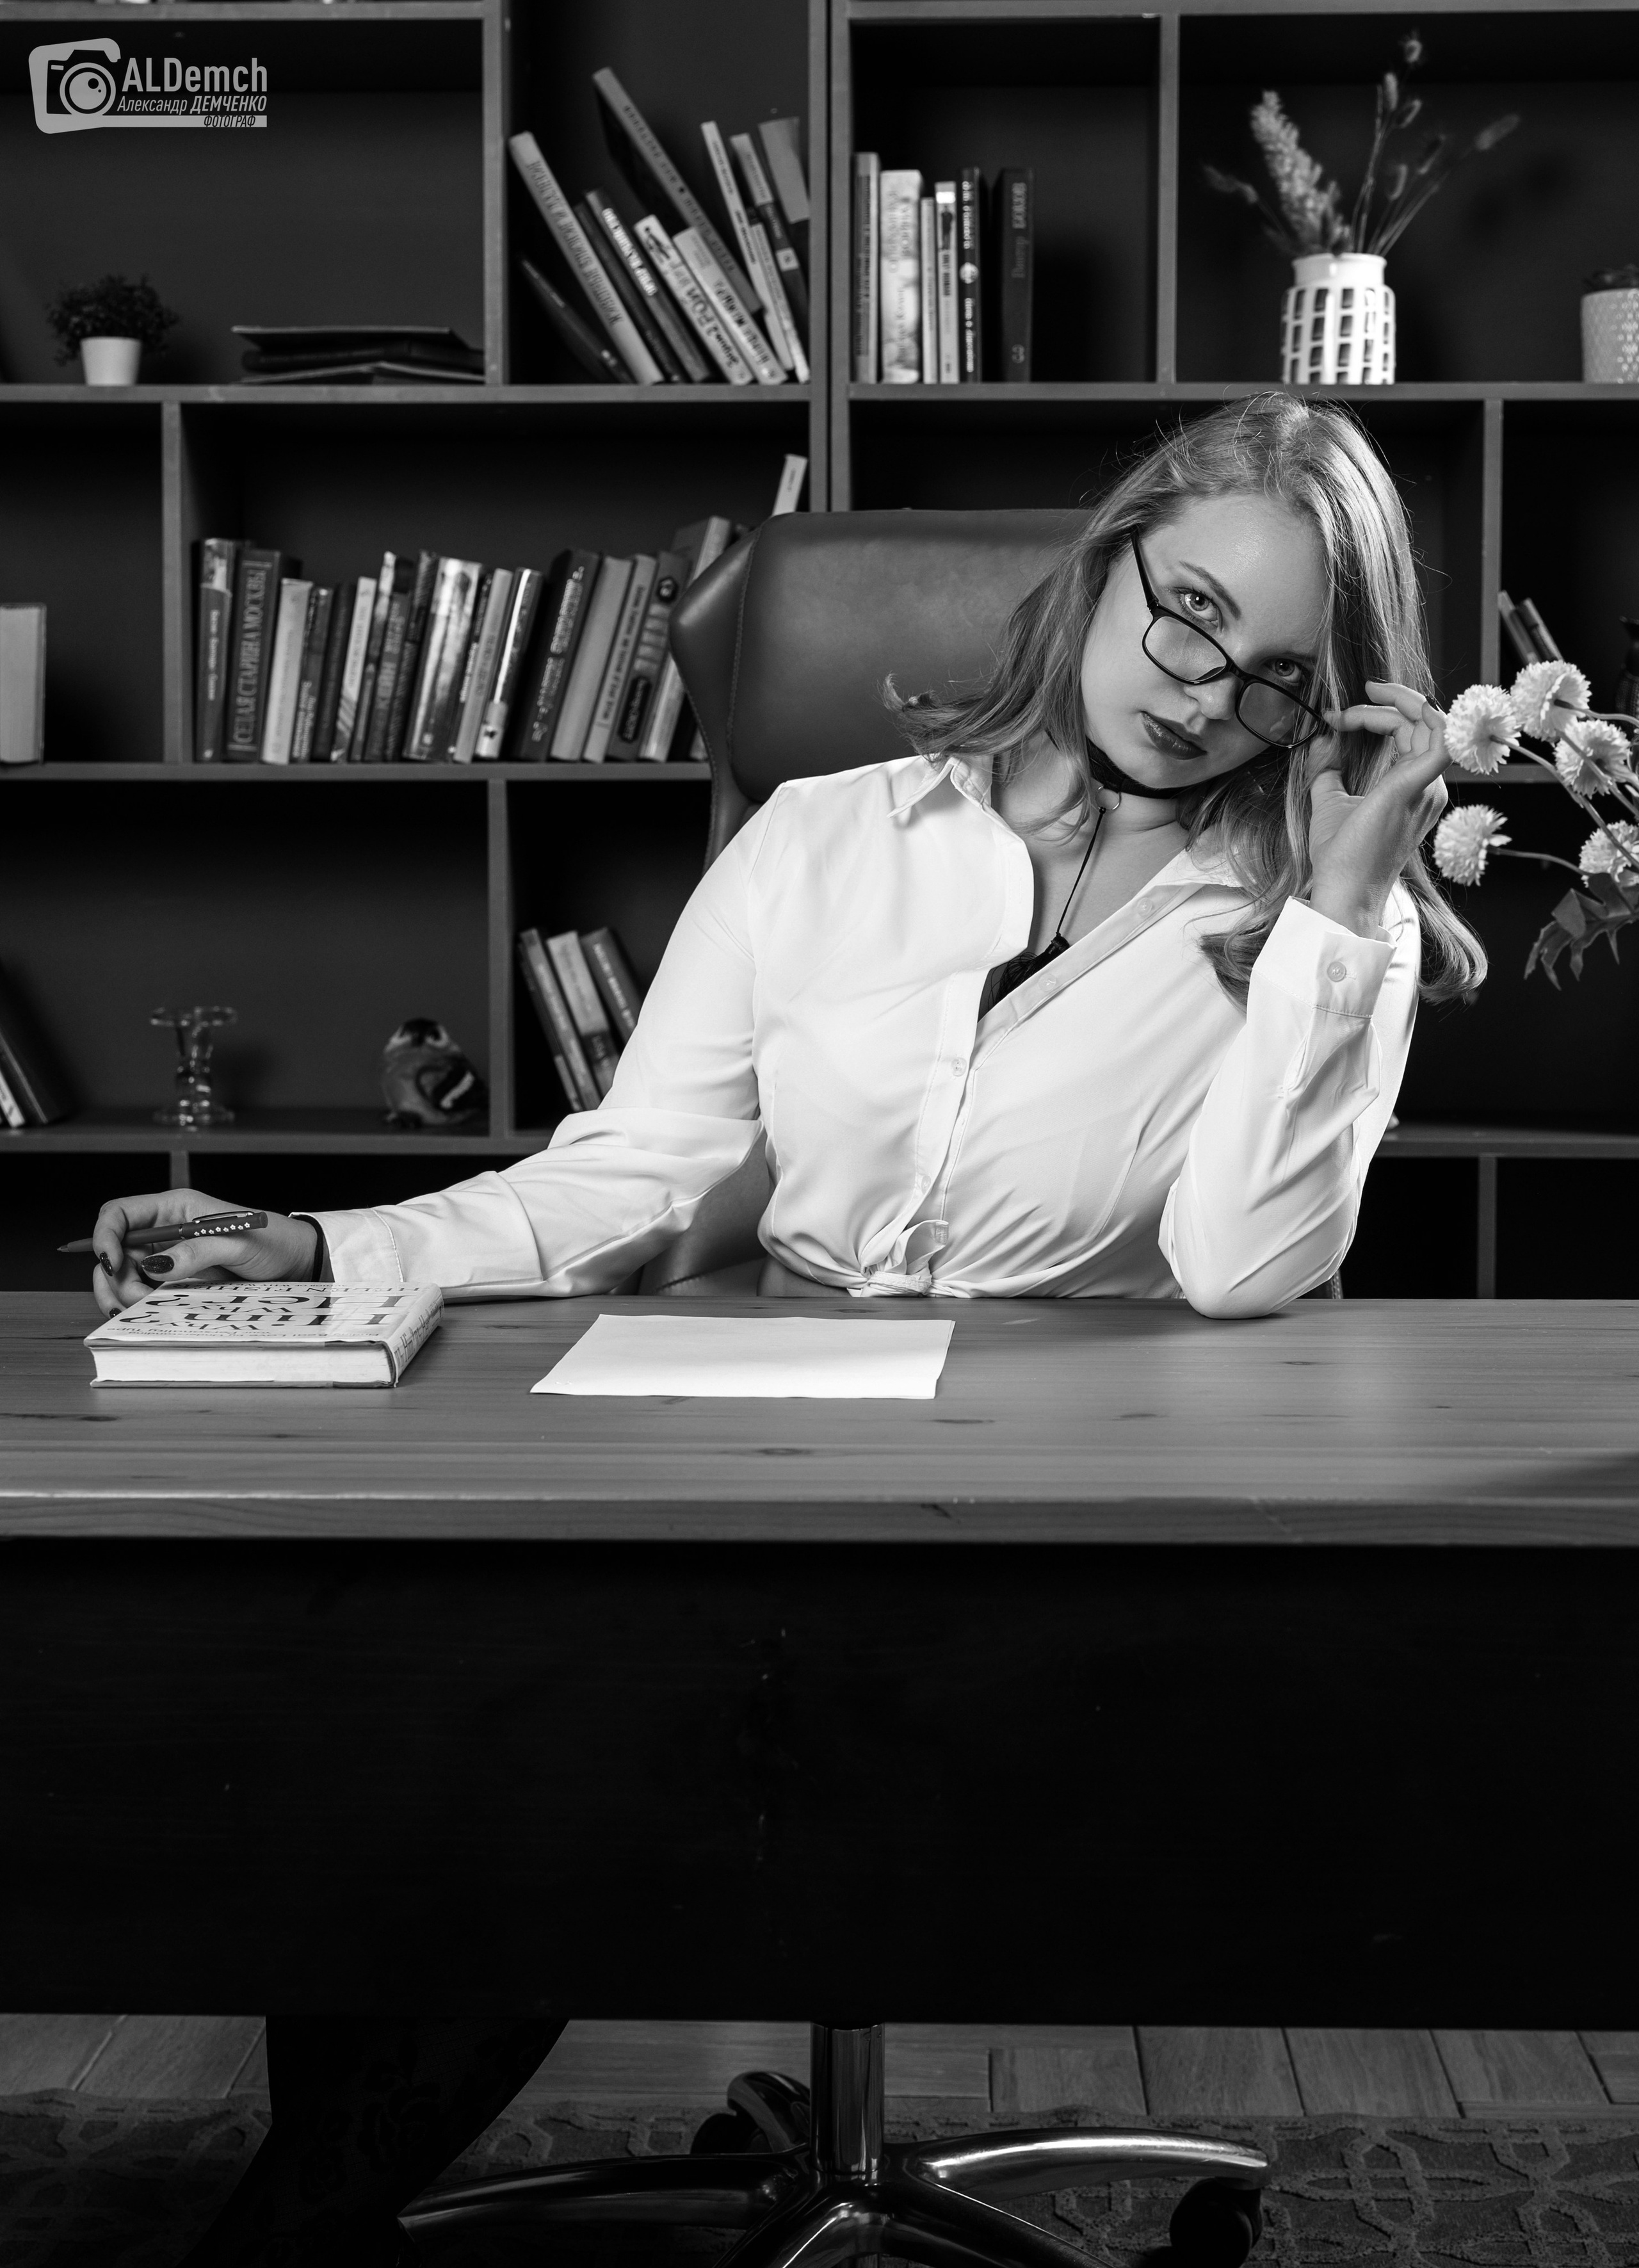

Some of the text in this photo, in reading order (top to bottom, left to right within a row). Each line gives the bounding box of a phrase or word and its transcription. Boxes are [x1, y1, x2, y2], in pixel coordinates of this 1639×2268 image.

[171, 1283, 293, 1292] FISHER
[183, 1304, 293, 1313] Why
[154, 1321, 260, 1330] Why
